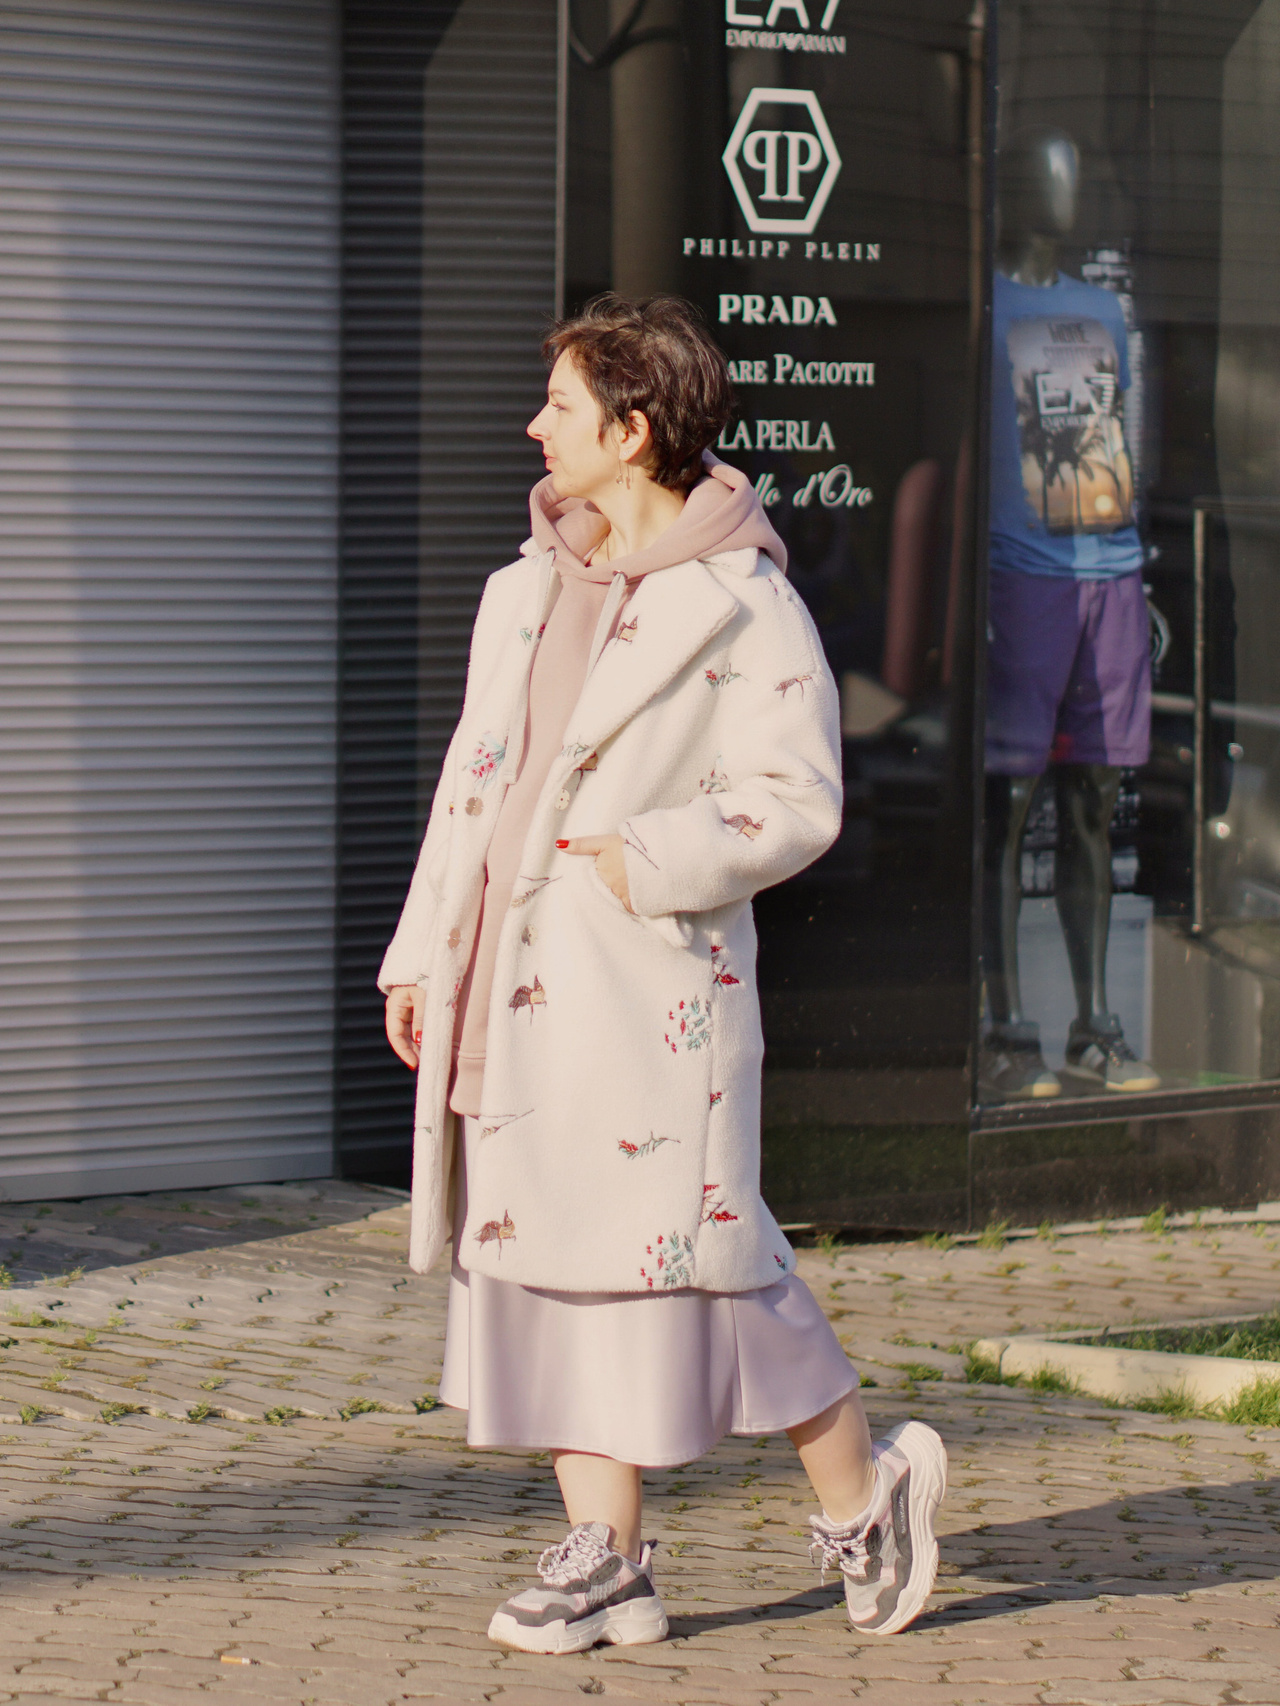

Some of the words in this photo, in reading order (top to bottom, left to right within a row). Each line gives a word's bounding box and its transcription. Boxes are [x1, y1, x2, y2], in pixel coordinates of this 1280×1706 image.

[683, 238, 791, 258] PHILIPP
[805, 242, 880, 260] PLEIN
[719, 295, 837, 326] PRADA
[727, 361, 768, 384] ARE
[773, 353, 875, 385] PACIOTTI
[755, 420, 836, 451] PERLA
[793, 464, 873, 507] d'Oro
